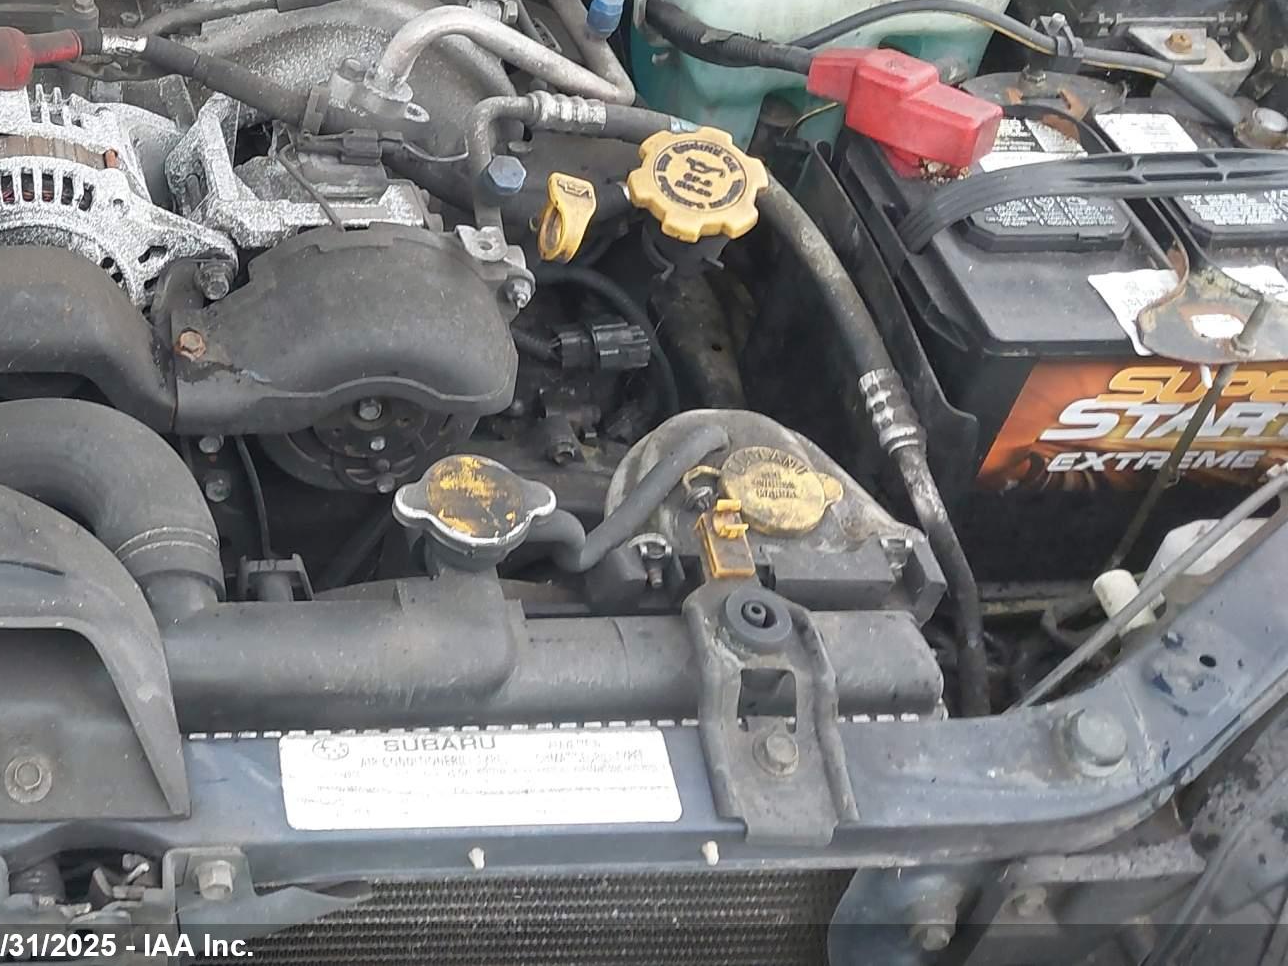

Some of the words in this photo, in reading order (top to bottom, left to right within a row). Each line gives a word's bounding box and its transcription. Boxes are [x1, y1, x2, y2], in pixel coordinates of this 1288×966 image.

[1039, 398, 1288, 442] STAR
[1046, 449, 1267, 473] EXTREME
[383, 735, 497, 752] SUBARU
